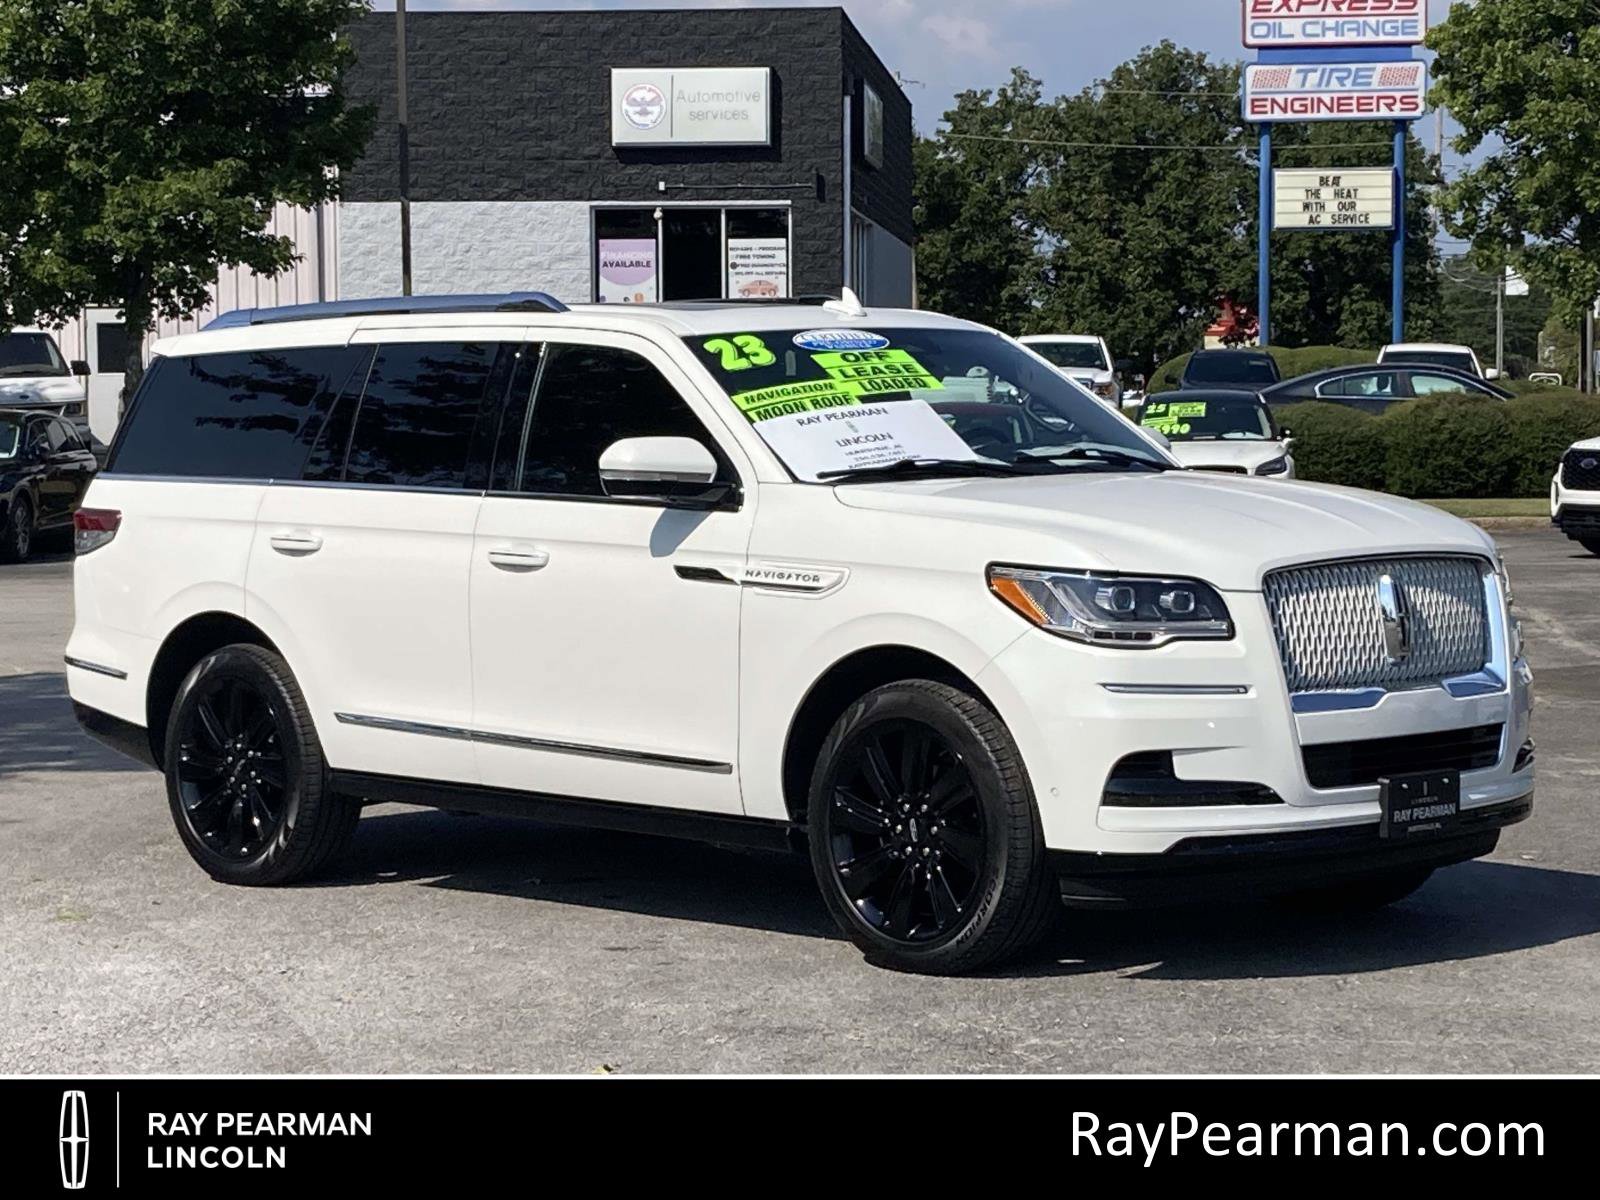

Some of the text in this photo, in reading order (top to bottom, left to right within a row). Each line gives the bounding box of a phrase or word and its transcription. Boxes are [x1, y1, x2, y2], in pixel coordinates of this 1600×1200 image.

[1251, 0, 1417, 13] EXPRESS
[1250, 19, 1419, 39] OIL CHANGE
[1295, 66, 1377, 89] TIRE
[676, 89, 761, 103] Automotive
[1250, 94, 1419, 115] ENGINEERS
[689, 109, 749, 121] services
[1319, 175, 1342, 187] BEAT
[1305, 188, 1359, 200] THE HEAT
[1302, 200, 1357, 213] WITH OUR
[1308, 212, 1370, 225] AC SERVICE
[602, 260, 652, 268] AVAILABLE
[703, 335, 776, 372] 23
[840, 351, 891, 364] OFF
[839, 363, 922, 378] LEASE
[859, 377, 929, 392] LOADED
[743, 382, 835, 405] NAVIGATION
[755, 393, 854, 421] MOON ROOF
[796, 407, 889, 427] RAY PEARMAN
[835, 432, 894, 447] LINCOLN
[745, 570, 821, 583] NAVIGATOR
[1393, 803, 1456, 823] RAY PEARMAN
